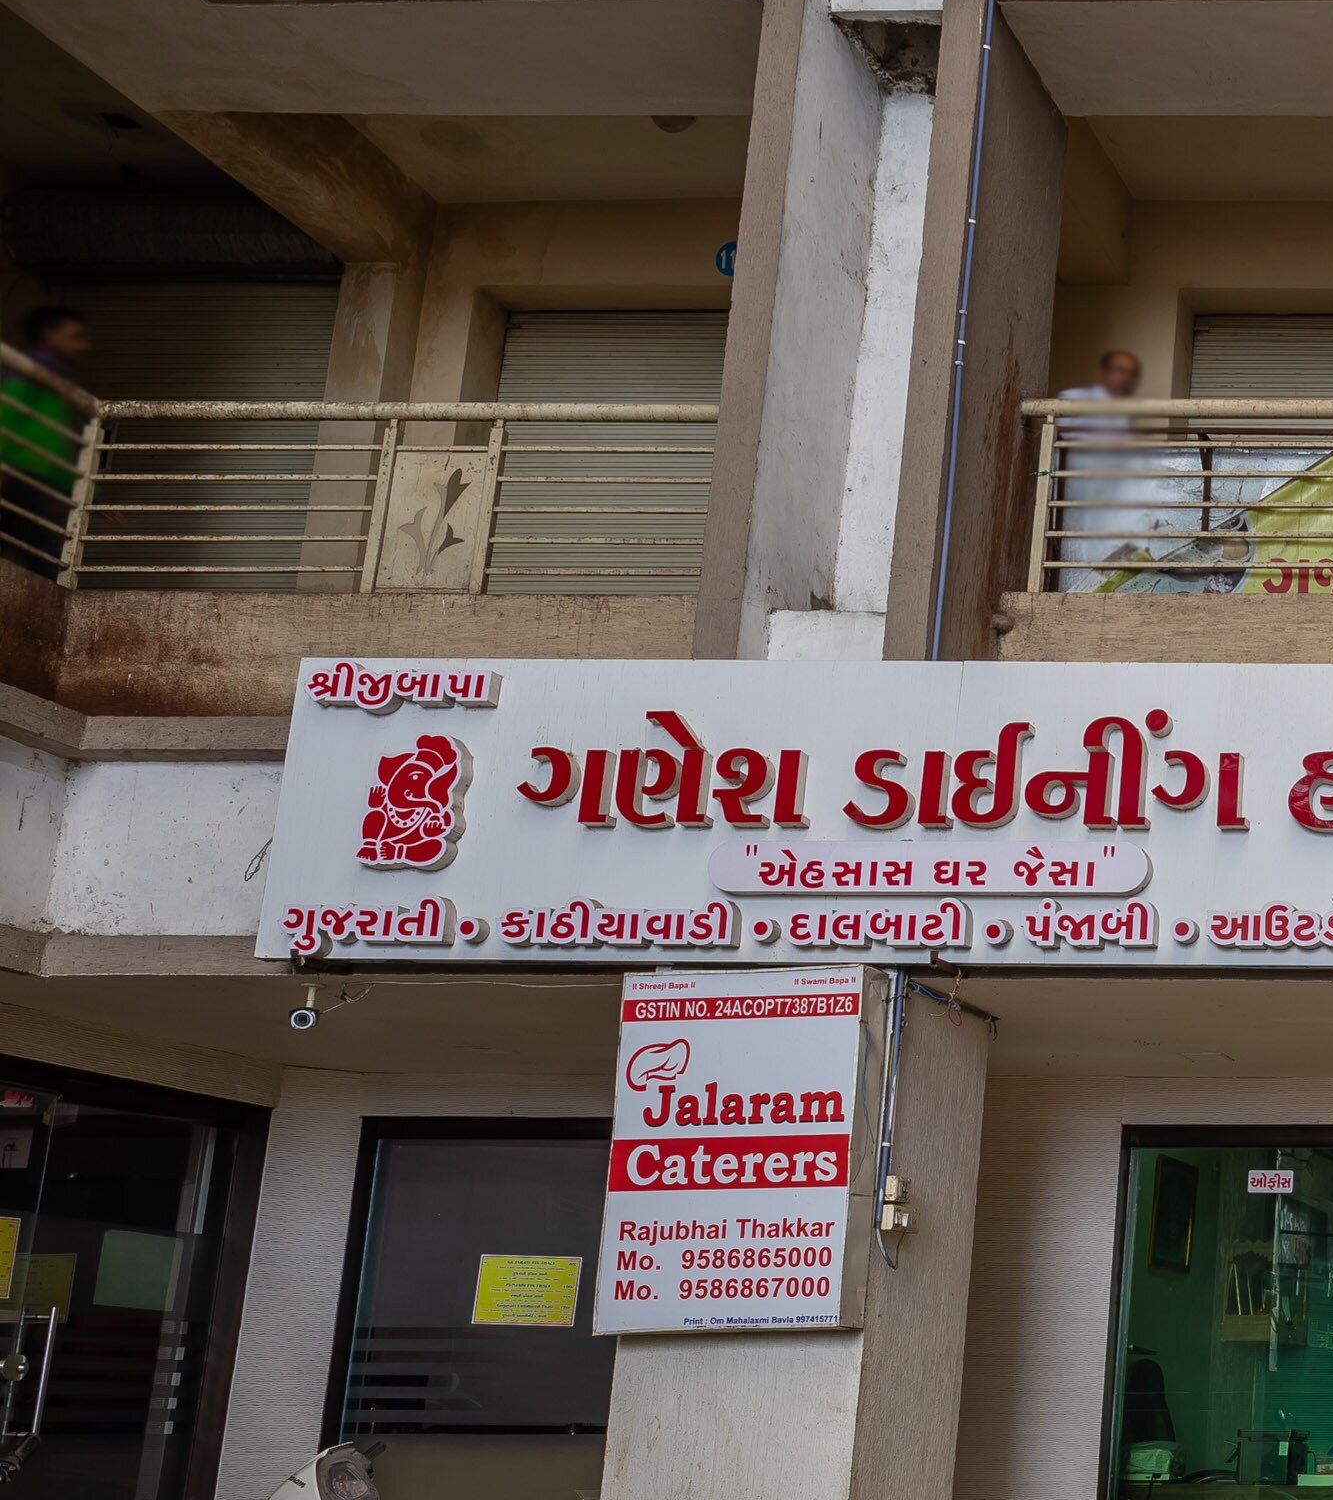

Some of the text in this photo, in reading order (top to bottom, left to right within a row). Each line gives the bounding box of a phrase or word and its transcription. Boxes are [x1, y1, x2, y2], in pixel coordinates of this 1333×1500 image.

[307, 661, 495, 712] શ્રીજીબાપા
[516, 710, 811, 830] ગણેશ
[842, 708, 1250, 831] ડાઈનીંગ
[933, 859, 986, 888] ઘર
[282, 897, 453, 958] ગુજરાતી
[501, 898, 742, 949] કાઠીયાવાડી
[788, 898, 973, 949] દાલબાટી
[1022, 898, 1160, 950] પંજાબી
[638, 981, 690, 991] Shreeji Bapa
[800, 977, 850, 986] Swami Bapa
[635, 1001, 681, 1020] GSTIN
[685, 1000, 711, 1019] NO.
[642, 1081, 845, 1128] Jalaram
[626, 1143, 838, 1187] Caterers
[1250, 1173, 1292, 1190] ઓફીસ
[618, 1218, 835, 1246] Rajubhai Thakkar
[616, 1247, 833, 1271] Mo. 9586865000
[614, 1276, 831, 1300] Mo. 9586867000
